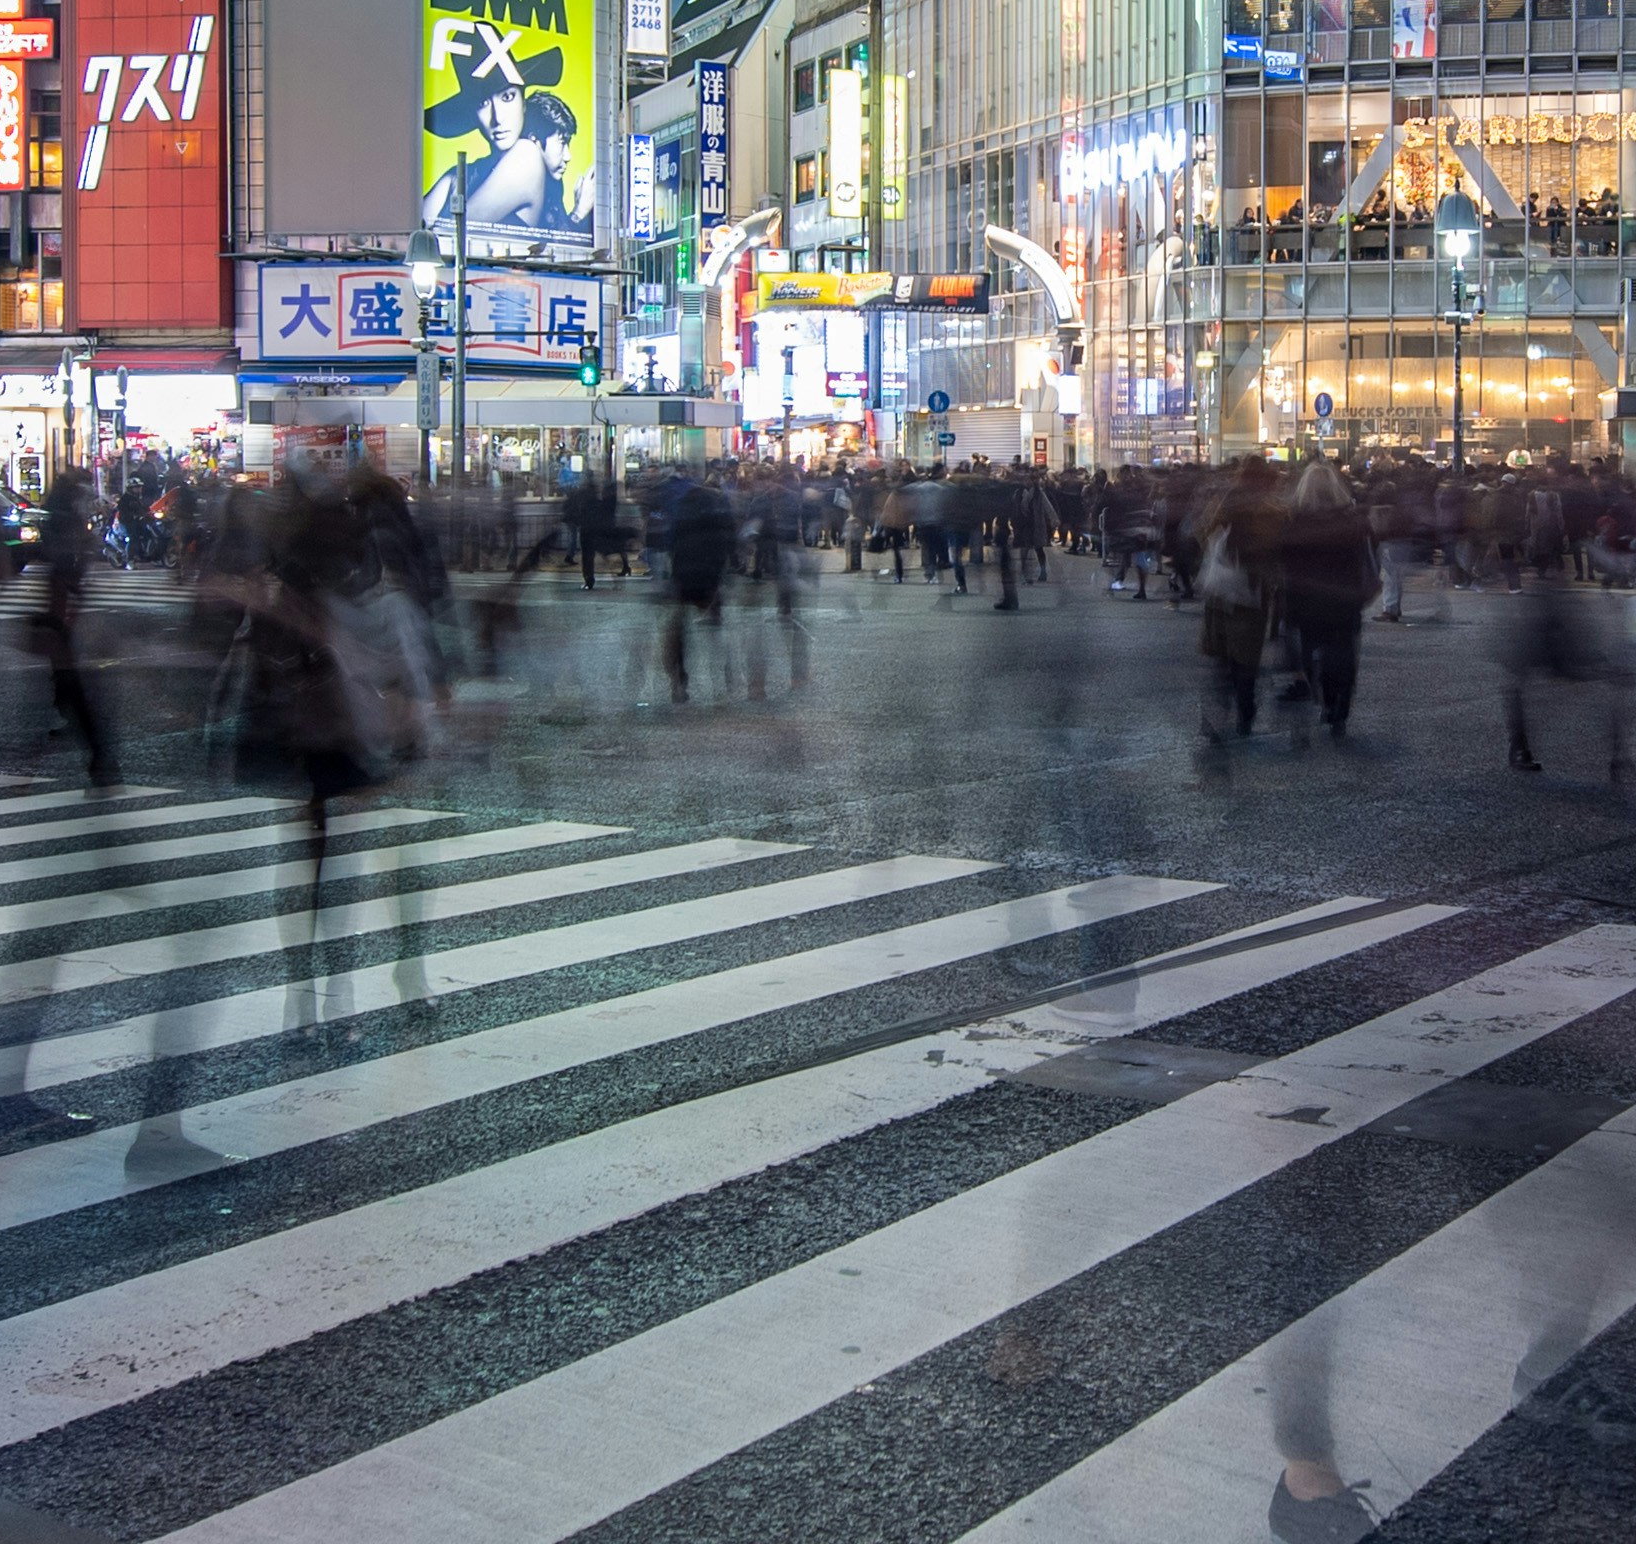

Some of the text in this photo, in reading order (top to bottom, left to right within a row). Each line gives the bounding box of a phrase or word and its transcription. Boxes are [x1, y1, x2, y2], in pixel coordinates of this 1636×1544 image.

[631, 5, 662, 18] 3719
[631, 16, 662, 31] 2468
[428, 16, 526, 87] FX
[76, 13, 216, 191] クスリ
[700, 70, 728, 216] 洋服の青山
[292, 374, 352, 385] TAISEIDO
[420, 358, 432, 418] 文化村通り
[1332, 406, 1443, 419] RBUCKS COFFEE
